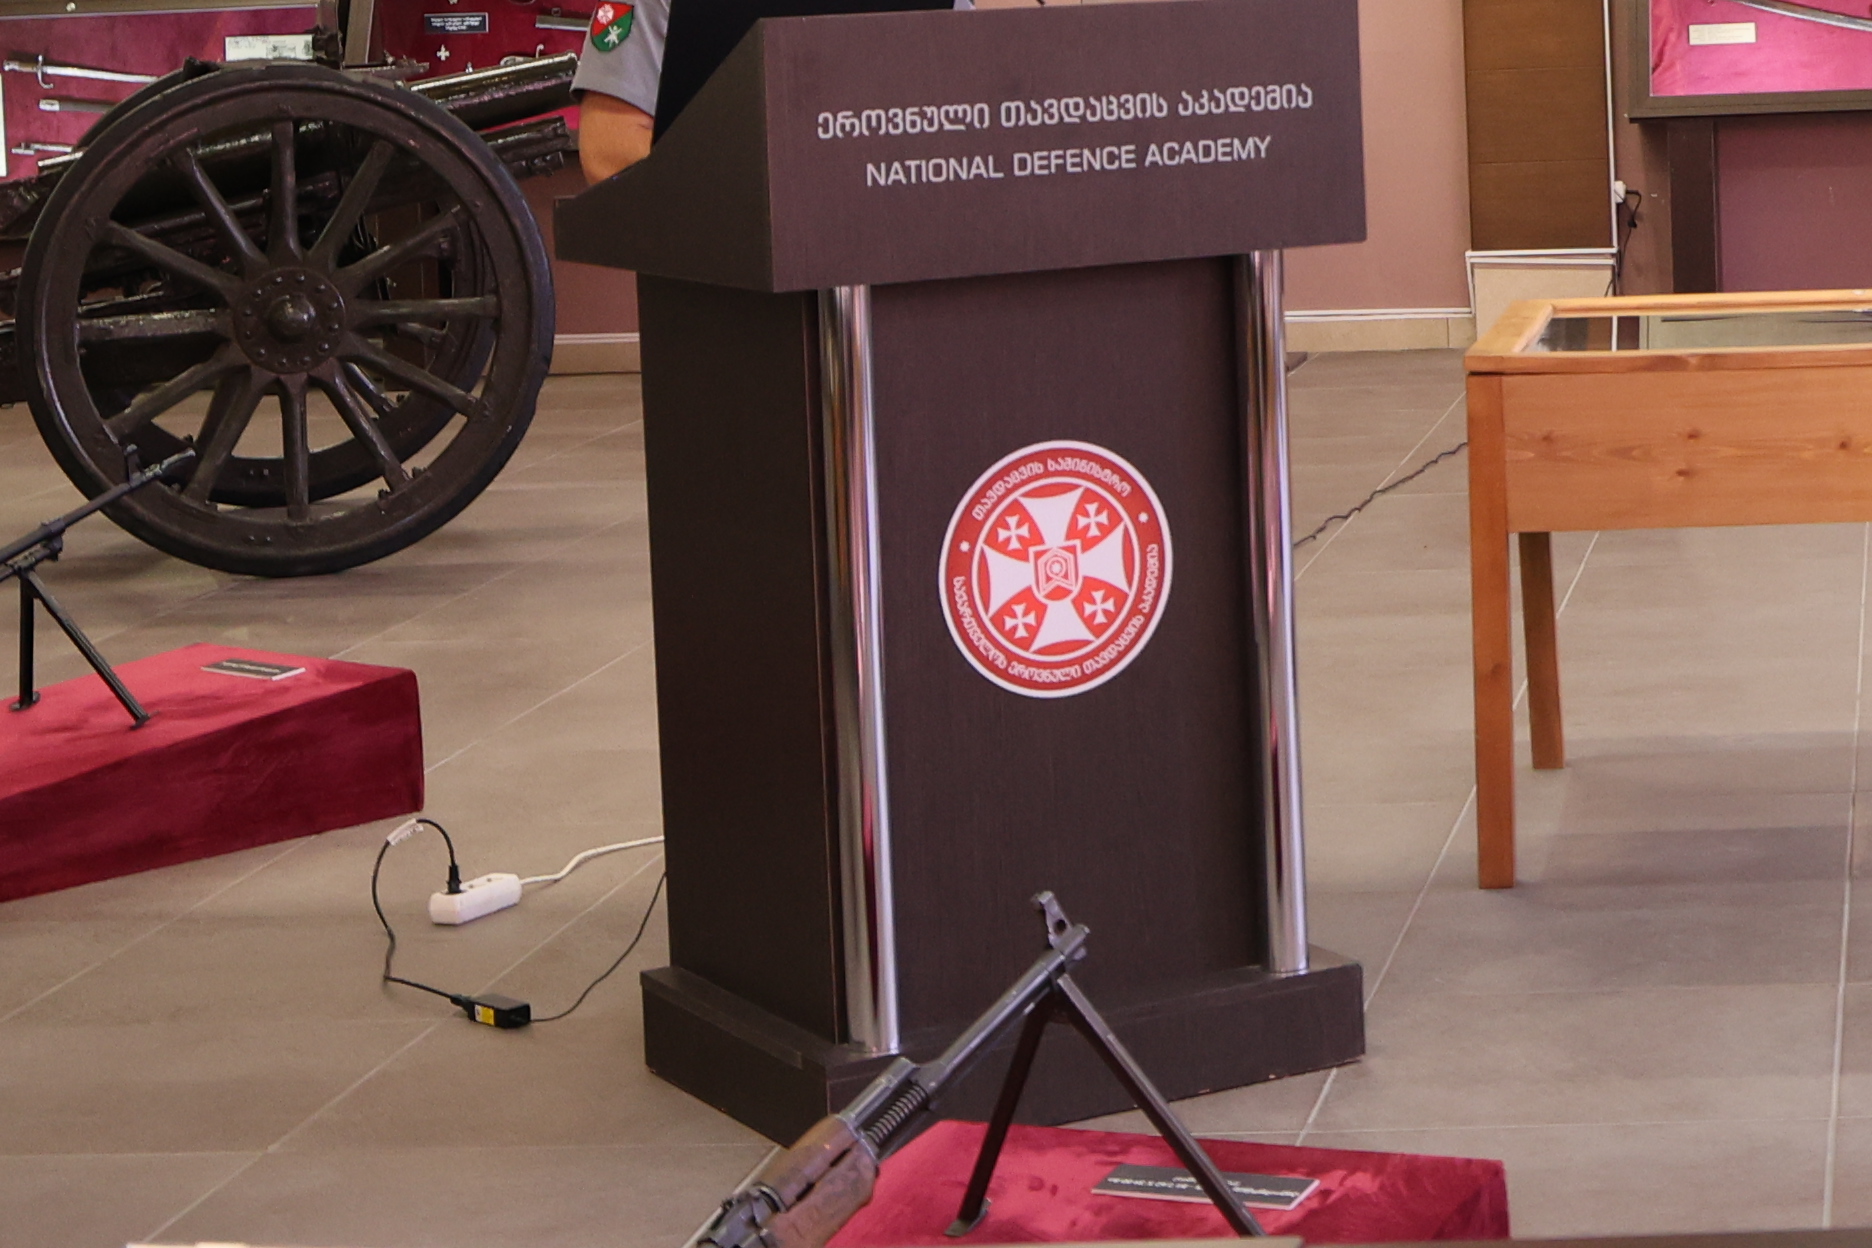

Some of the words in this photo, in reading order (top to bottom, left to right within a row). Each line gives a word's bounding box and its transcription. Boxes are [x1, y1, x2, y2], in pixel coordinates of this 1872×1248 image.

[817, 101, 992, 140] ეროვნული
[1000, 91, 1168, 129] თავდაცვის
[1177, 82, 1314, 117] აკადემია
[866, 154, 1004, 187] NATIONAL
[1013, 143, 1137, 178] DEFENCE
[1144, 135, 1272, 167] ACADEMY
